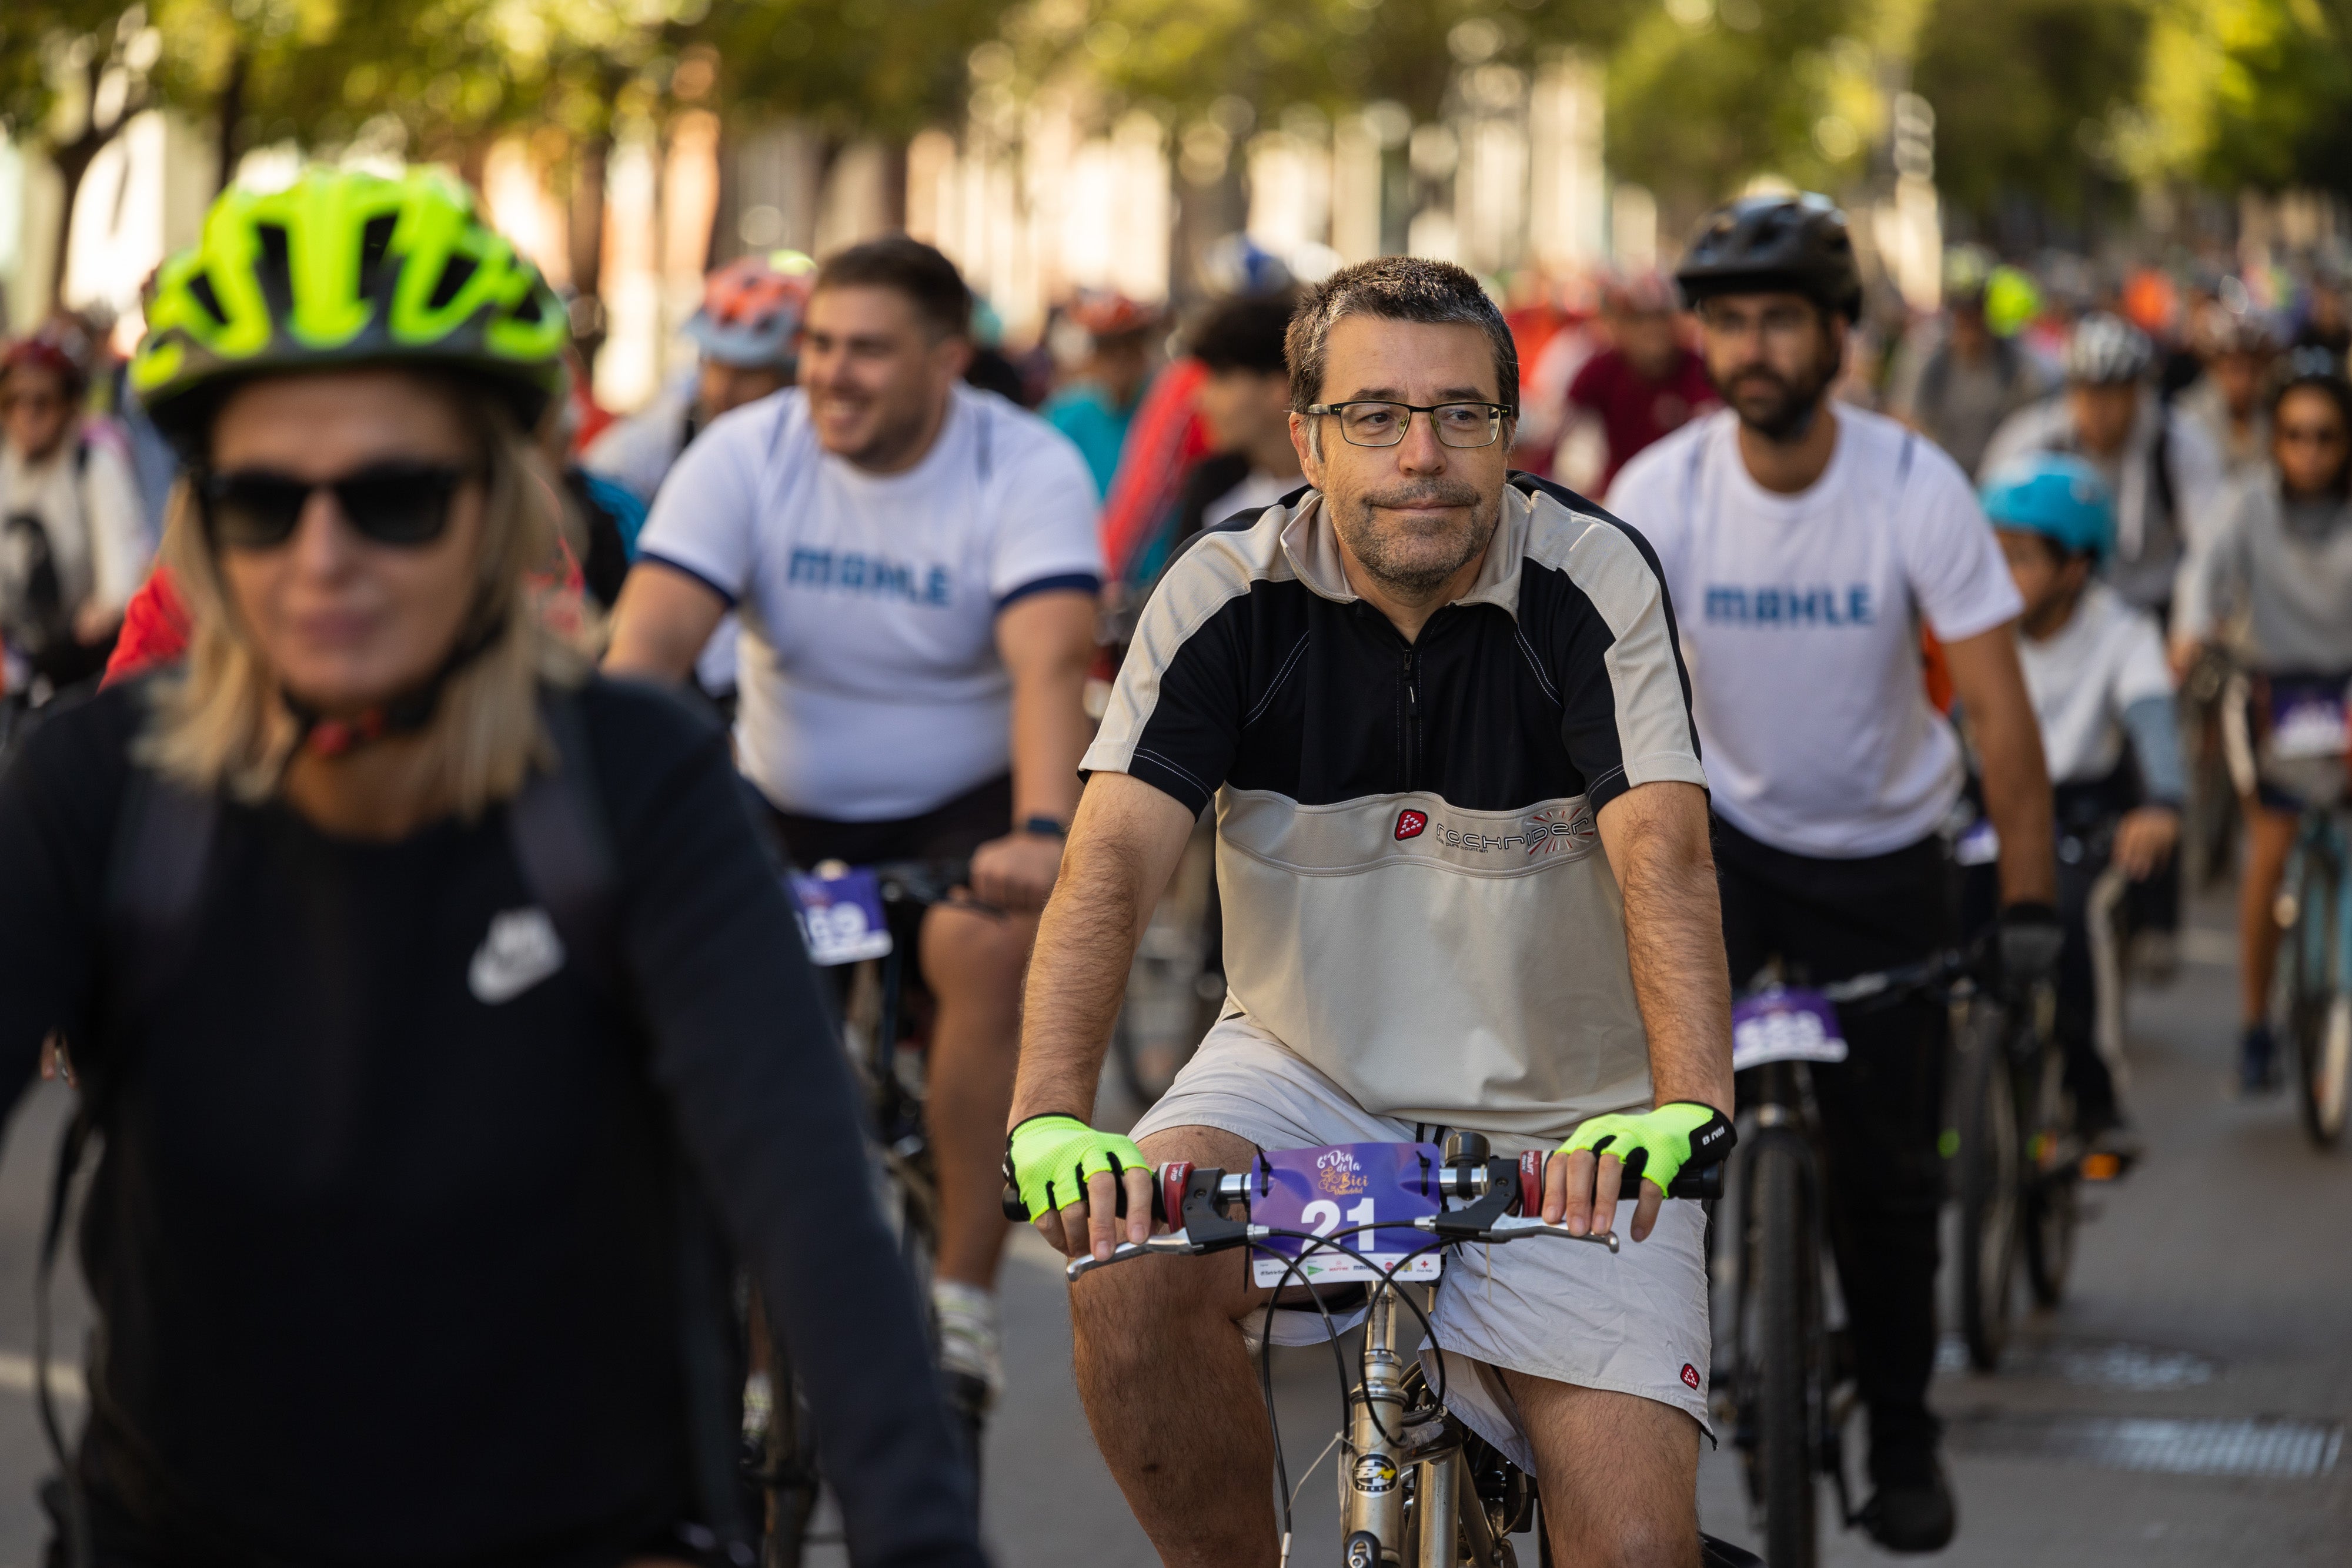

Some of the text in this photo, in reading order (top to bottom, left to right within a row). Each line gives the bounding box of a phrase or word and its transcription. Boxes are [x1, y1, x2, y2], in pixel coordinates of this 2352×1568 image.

[1705, 586, 1873, 626] MAHLE
[1339, 1172, 1369, 1189] Bici
[1301, 1198, 1375, 1254] 21
